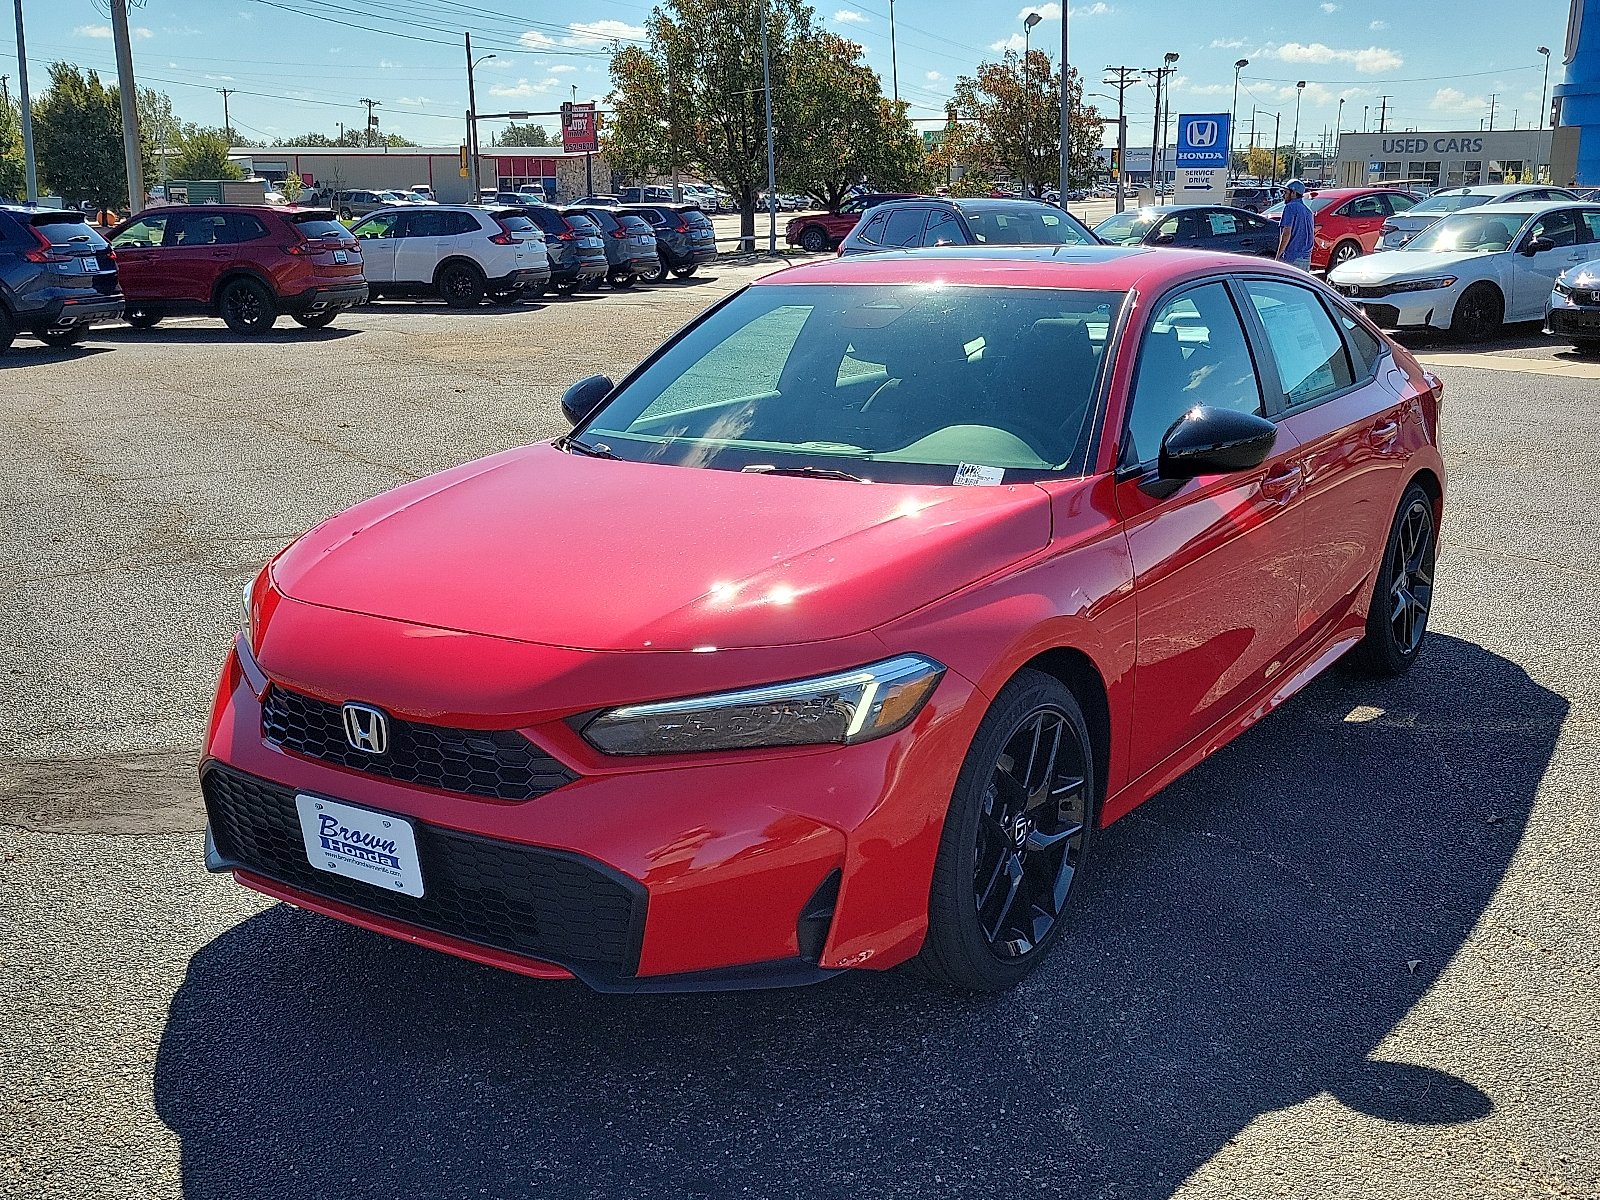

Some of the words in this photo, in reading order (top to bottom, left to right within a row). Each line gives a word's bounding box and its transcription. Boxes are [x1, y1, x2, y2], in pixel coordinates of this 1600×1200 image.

[1178, 152, 1224, 160] HONDA
[1382, 139, 1428, 154] USED
[1433, 138, 1483, 153] CARS
[318, 813, 398, 854] Brown
[327, 839, 394, 868] Honda
